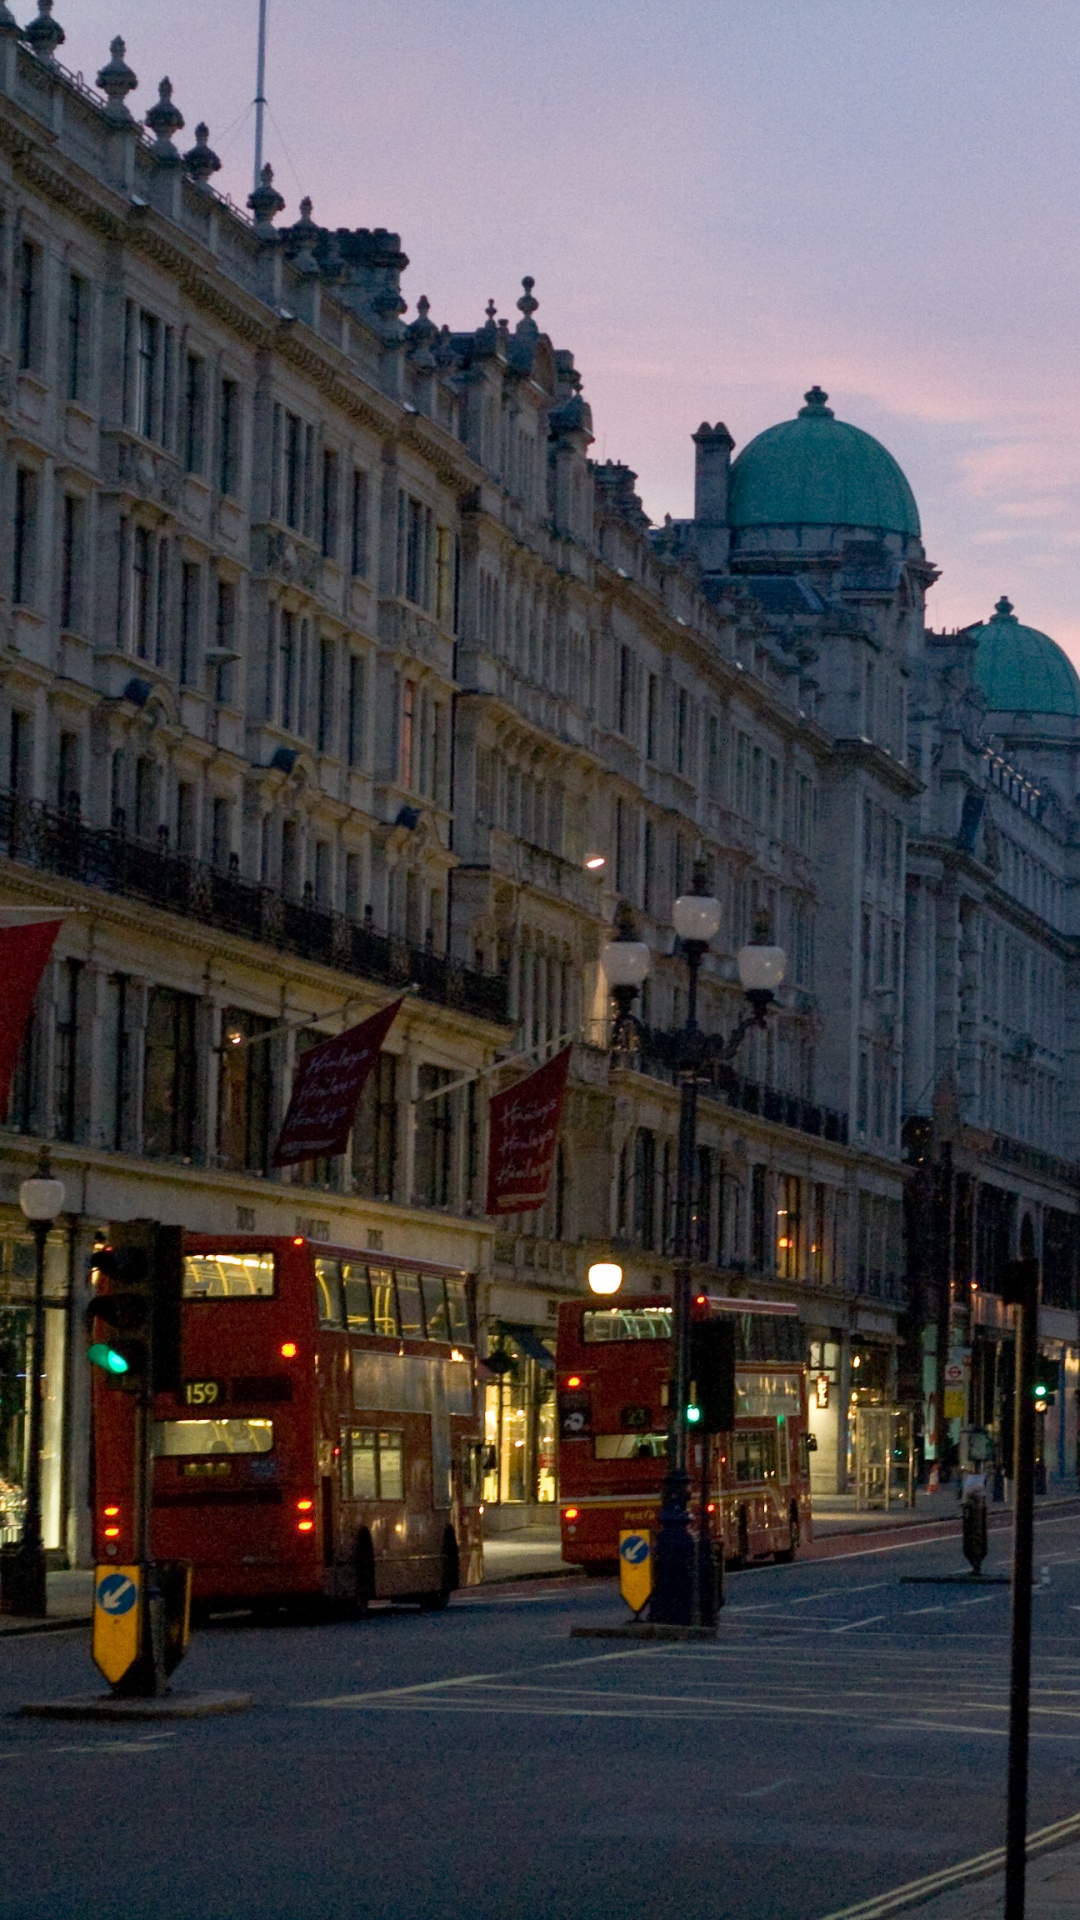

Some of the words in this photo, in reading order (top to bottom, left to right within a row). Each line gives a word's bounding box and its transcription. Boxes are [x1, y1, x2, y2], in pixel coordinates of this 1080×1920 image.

[304, 1048, 371, 1077] Hamleys
[285, 1104, 348, 1132] Hamleys
[498, 1129, 554, 1156] Hamleys
[495, 1157, 552, 1187] Hamleys
[186, 1382, 219, 1405] 159
